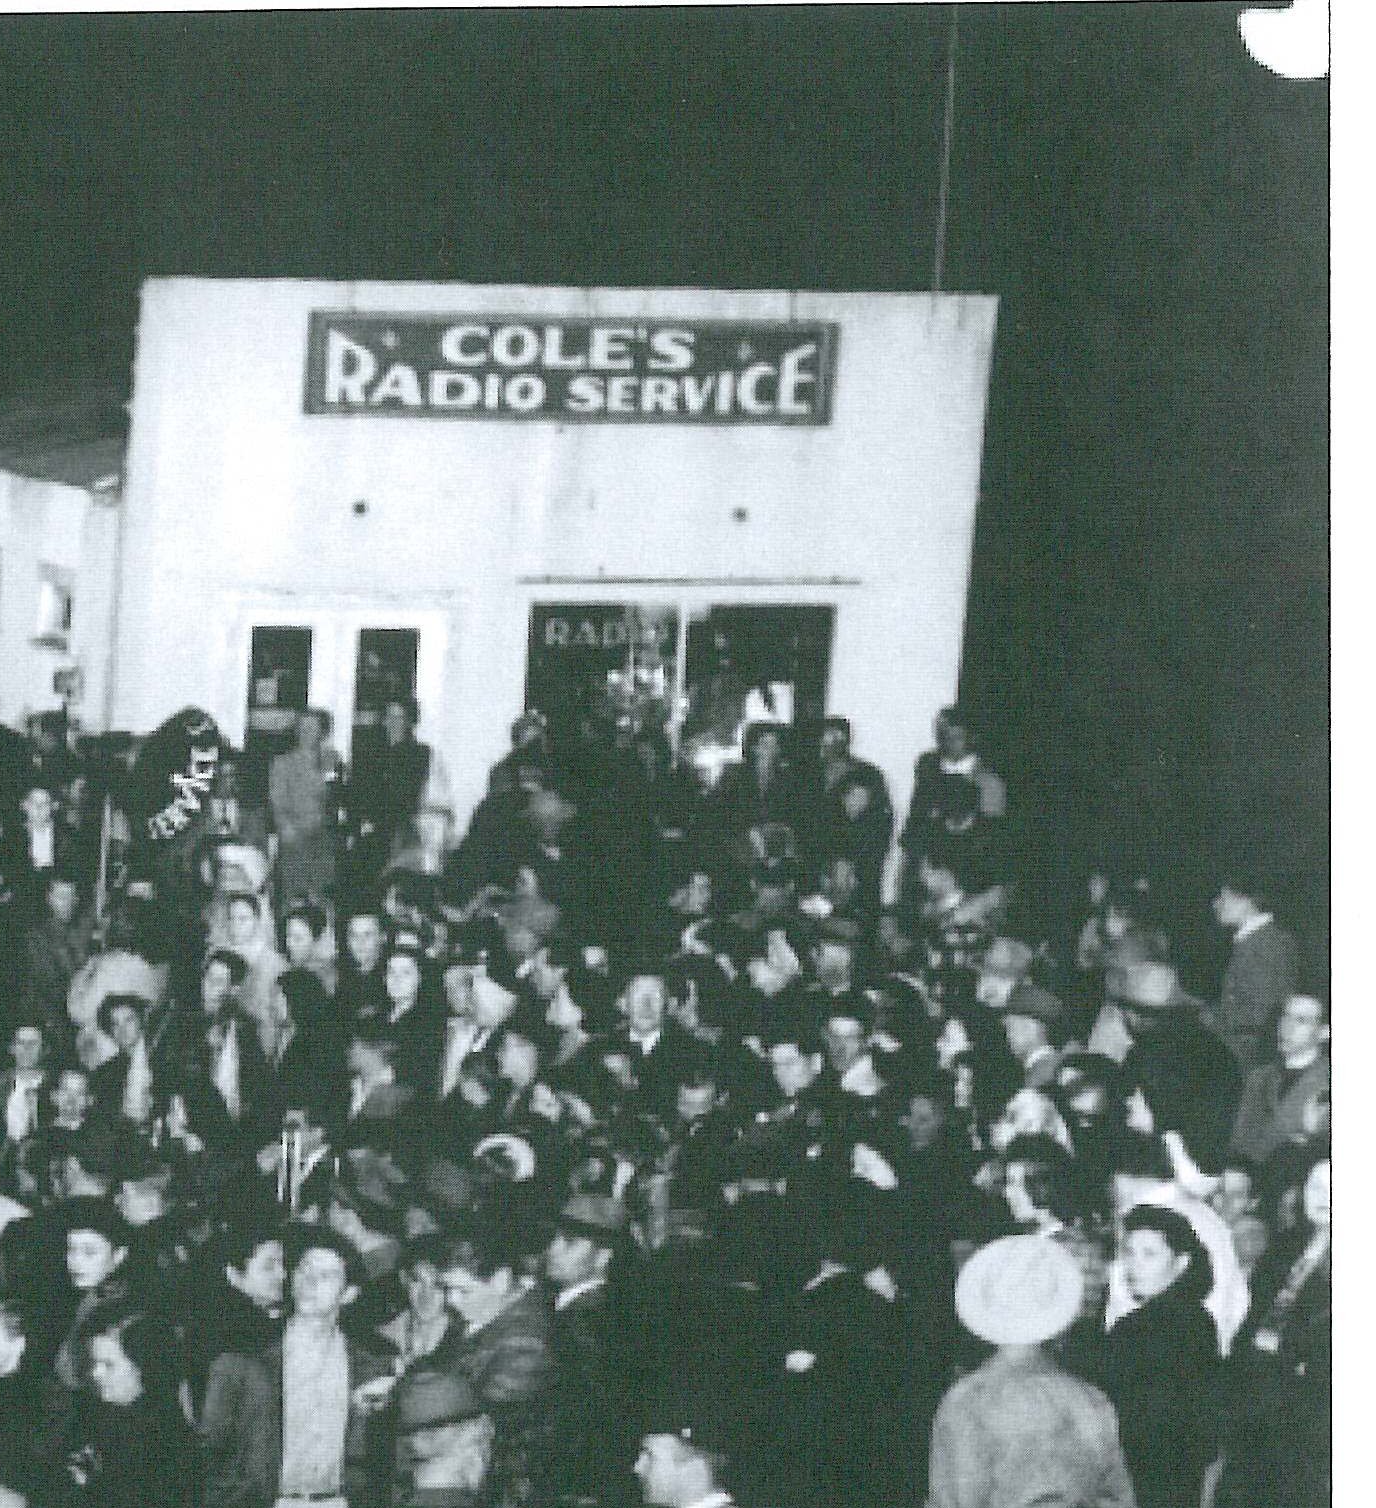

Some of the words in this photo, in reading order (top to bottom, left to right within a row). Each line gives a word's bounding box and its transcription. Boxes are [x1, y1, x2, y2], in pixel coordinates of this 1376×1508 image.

[441, 326, 695, 370] COLE'S
[325, 331, 549, 407] RADIO
[565, 343, 817, 415] SERVICE
[544, 613, 670, 647] RAD
